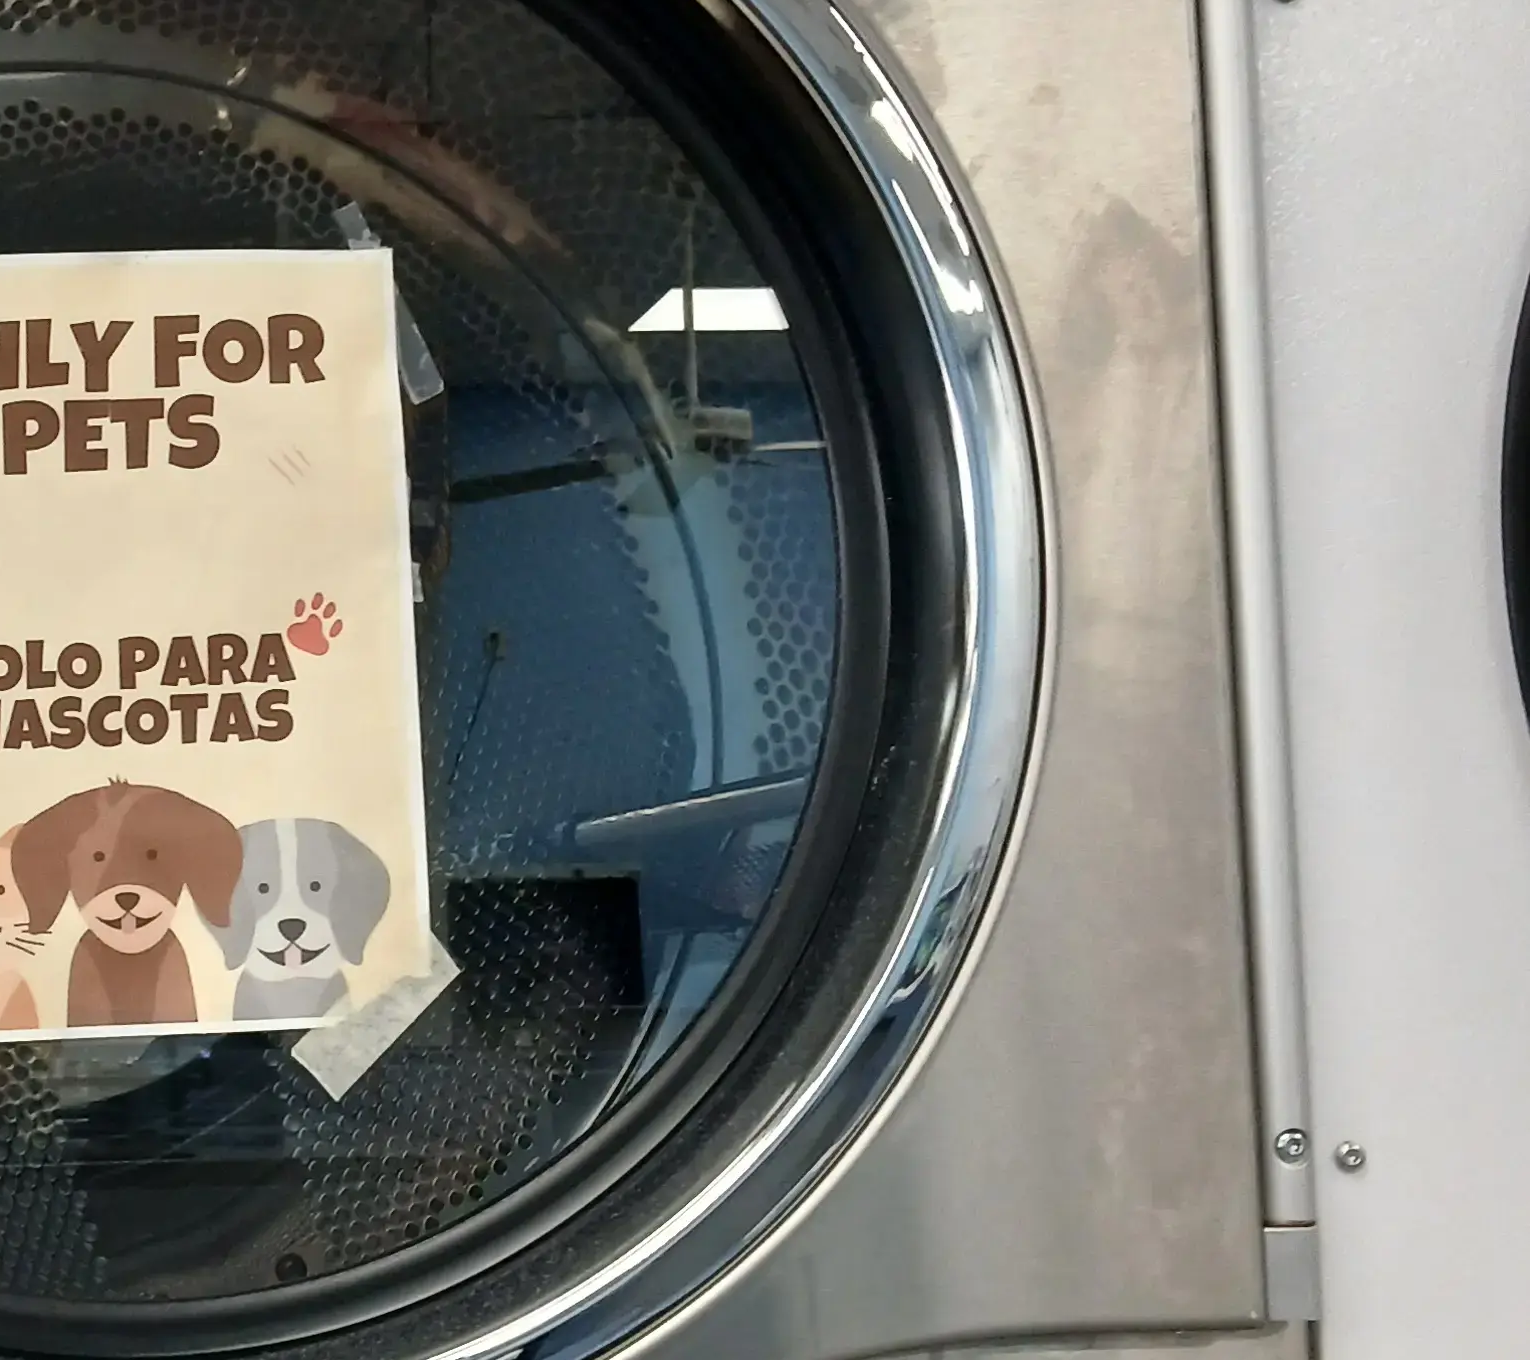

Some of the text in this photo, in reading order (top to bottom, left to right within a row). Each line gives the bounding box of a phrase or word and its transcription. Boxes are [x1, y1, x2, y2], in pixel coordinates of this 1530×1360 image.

[153, 313, 327, 388] FOR
[1, 394, 221, 476] PETS
[118, 633, 297, 690] PARA
